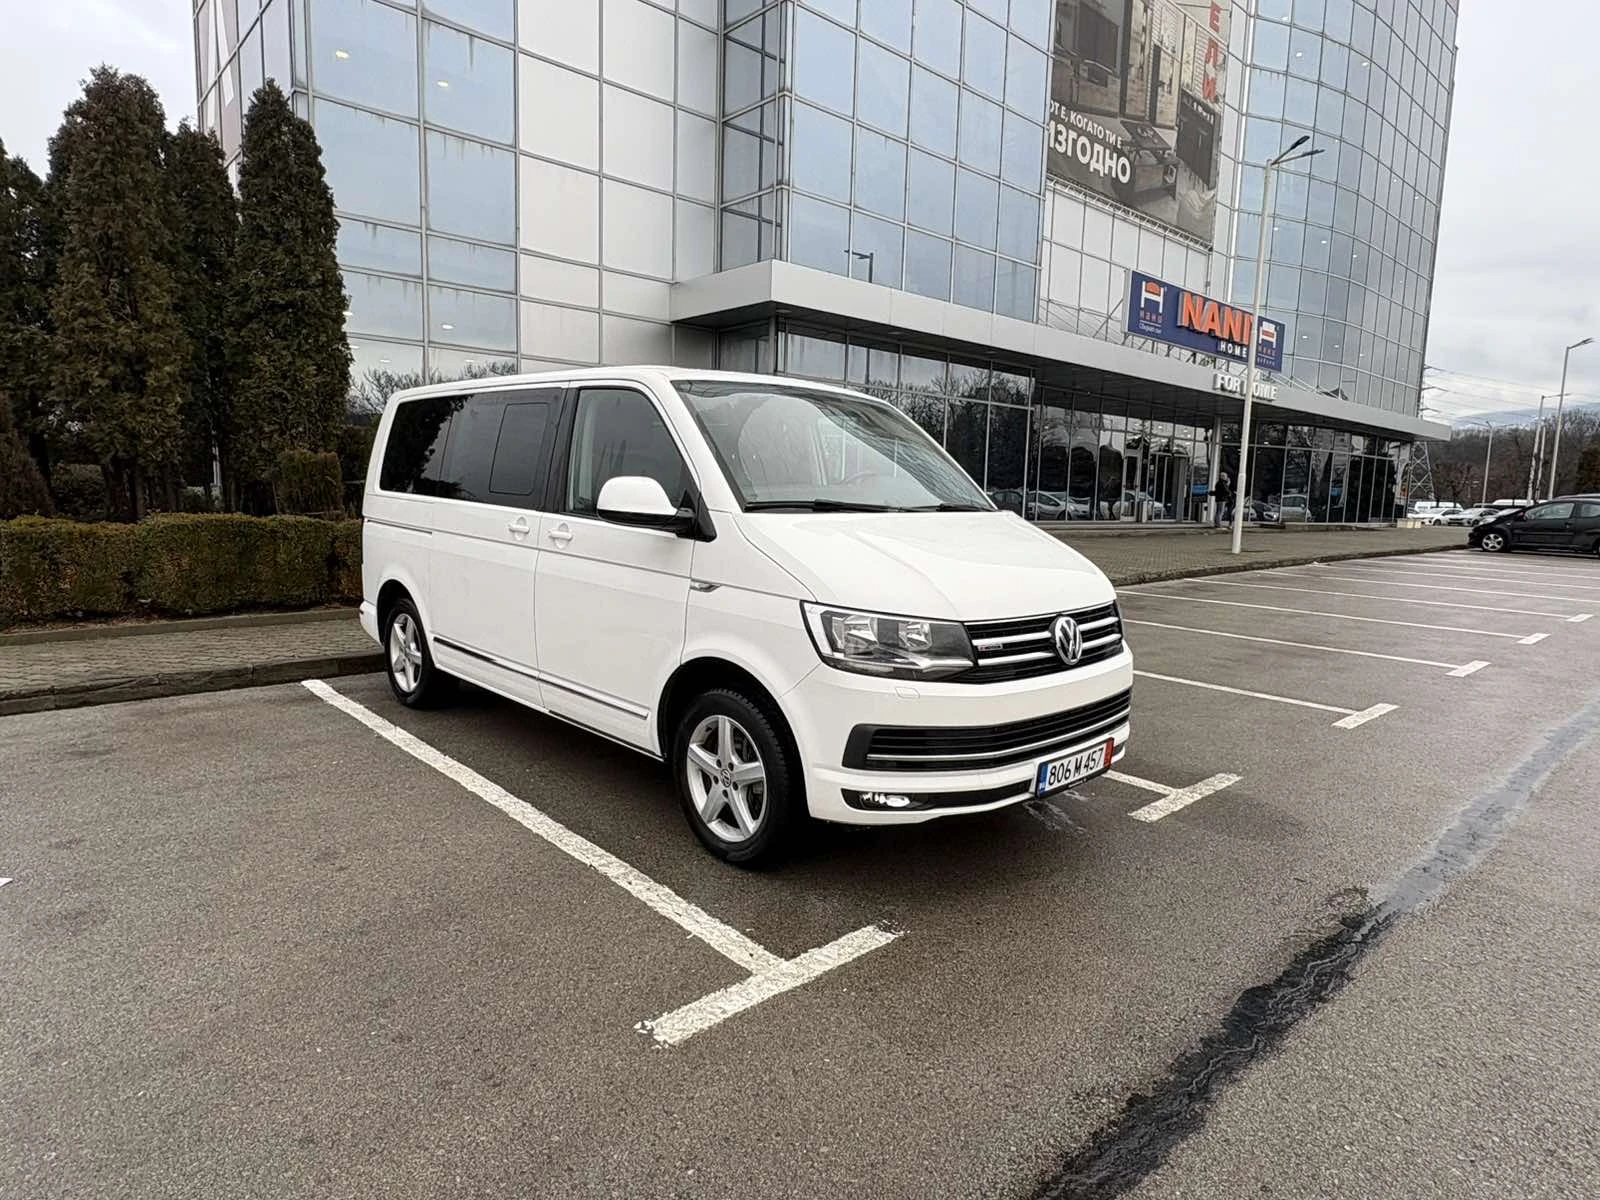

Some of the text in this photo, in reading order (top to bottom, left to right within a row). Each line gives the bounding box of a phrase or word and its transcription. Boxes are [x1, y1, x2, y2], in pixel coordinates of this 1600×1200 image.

[1070, 110, 1104, 139] КОГАТО
[1105, 129, 1116, 146] ТИ
[1220, 341, 1247, 358] HOME
[1048, 759, 1071, 786] 806
[1084, 747, 1104, 772] 457
